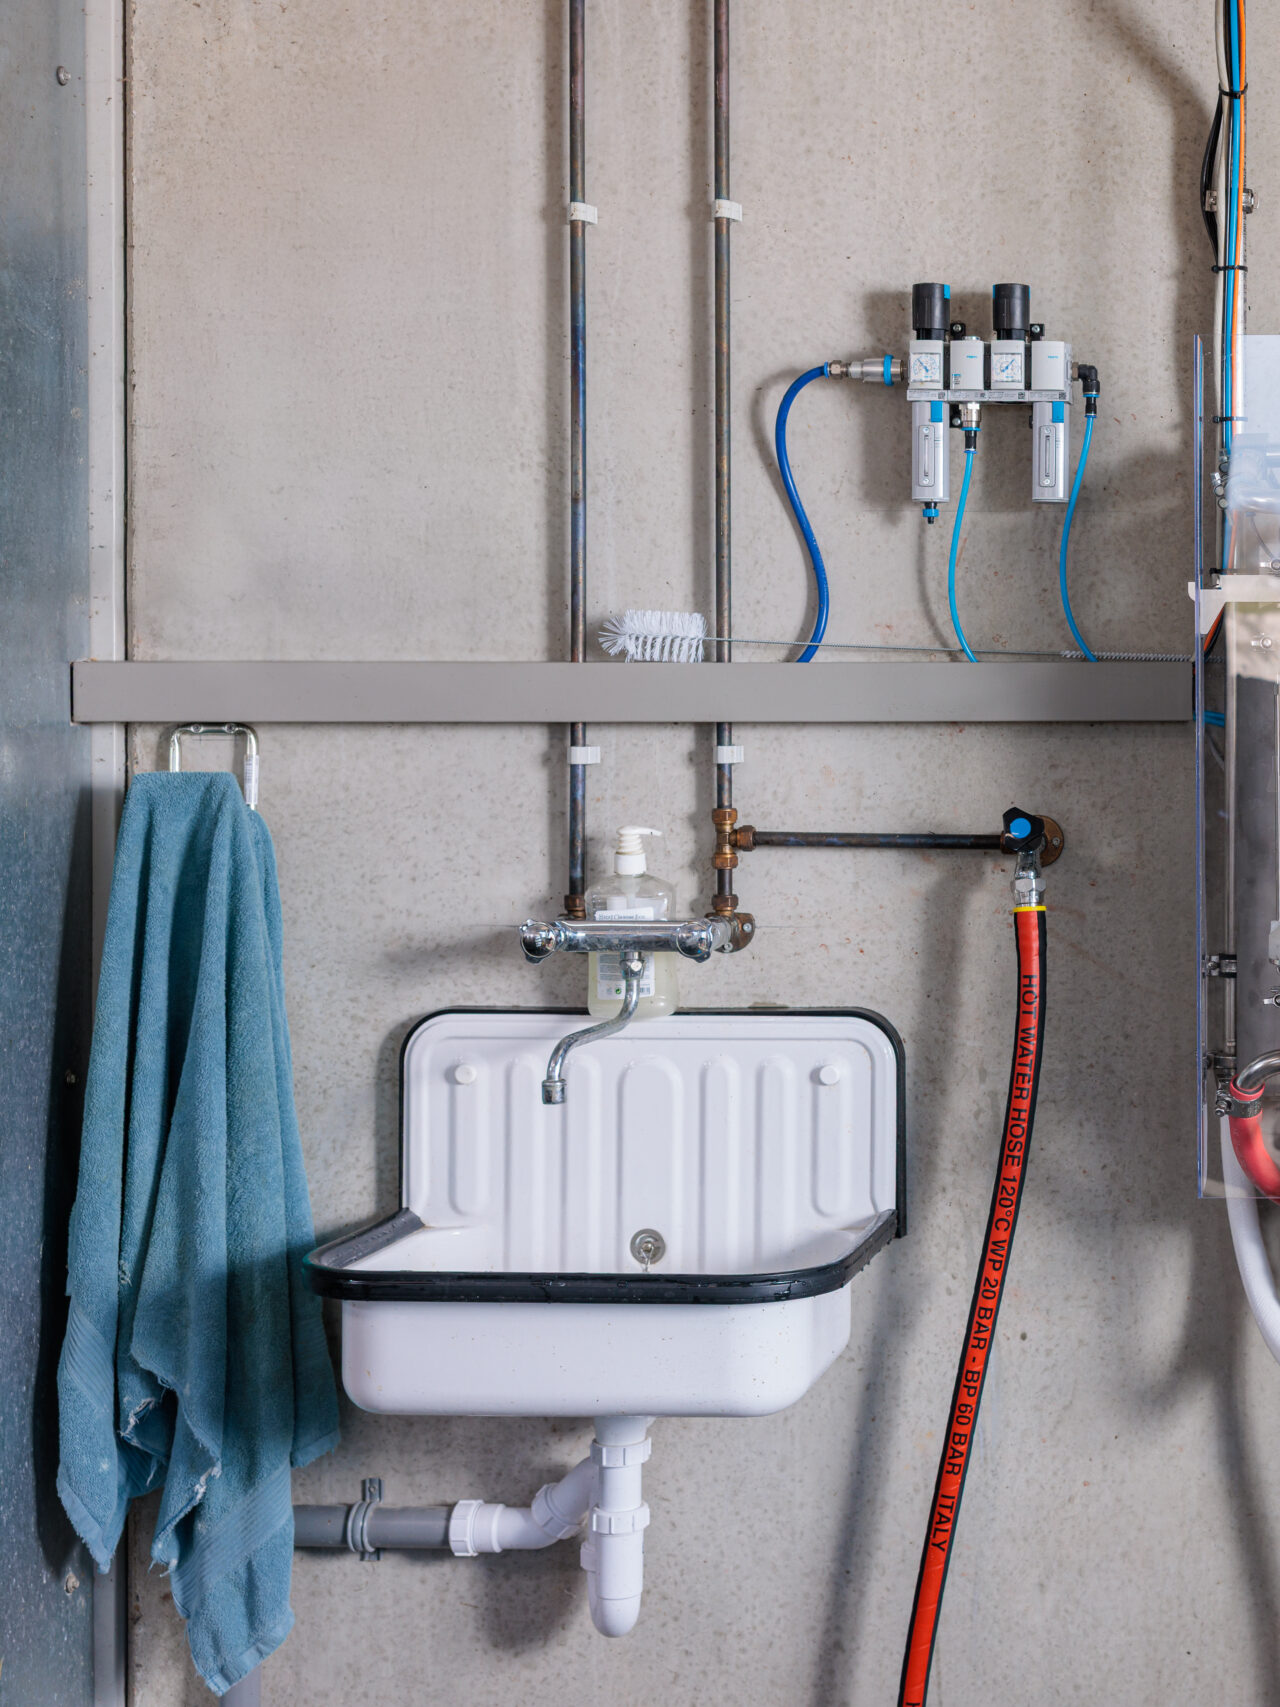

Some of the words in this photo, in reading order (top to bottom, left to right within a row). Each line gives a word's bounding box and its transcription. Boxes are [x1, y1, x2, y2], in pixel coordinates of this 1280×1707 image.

[1021, 974, 1038, 1020] HOT
[1015, 1026, 1037, 1101] WATER
[1005, 1107, 1026, 1167] HOSE
[994, 1175, 1017, 1232] 120°C
[988, 1239, 1007, 1272] WP
[981, 1277, 999, 1300] 20
[971, 1306, 993, 1350] BAR
[963, 1369, 982, 1398] BP
[956, 1403, 973, 1426] 60
[946, 1431, 967, 1475] BAR
[931, 1493, 956, 1552] ITALY
